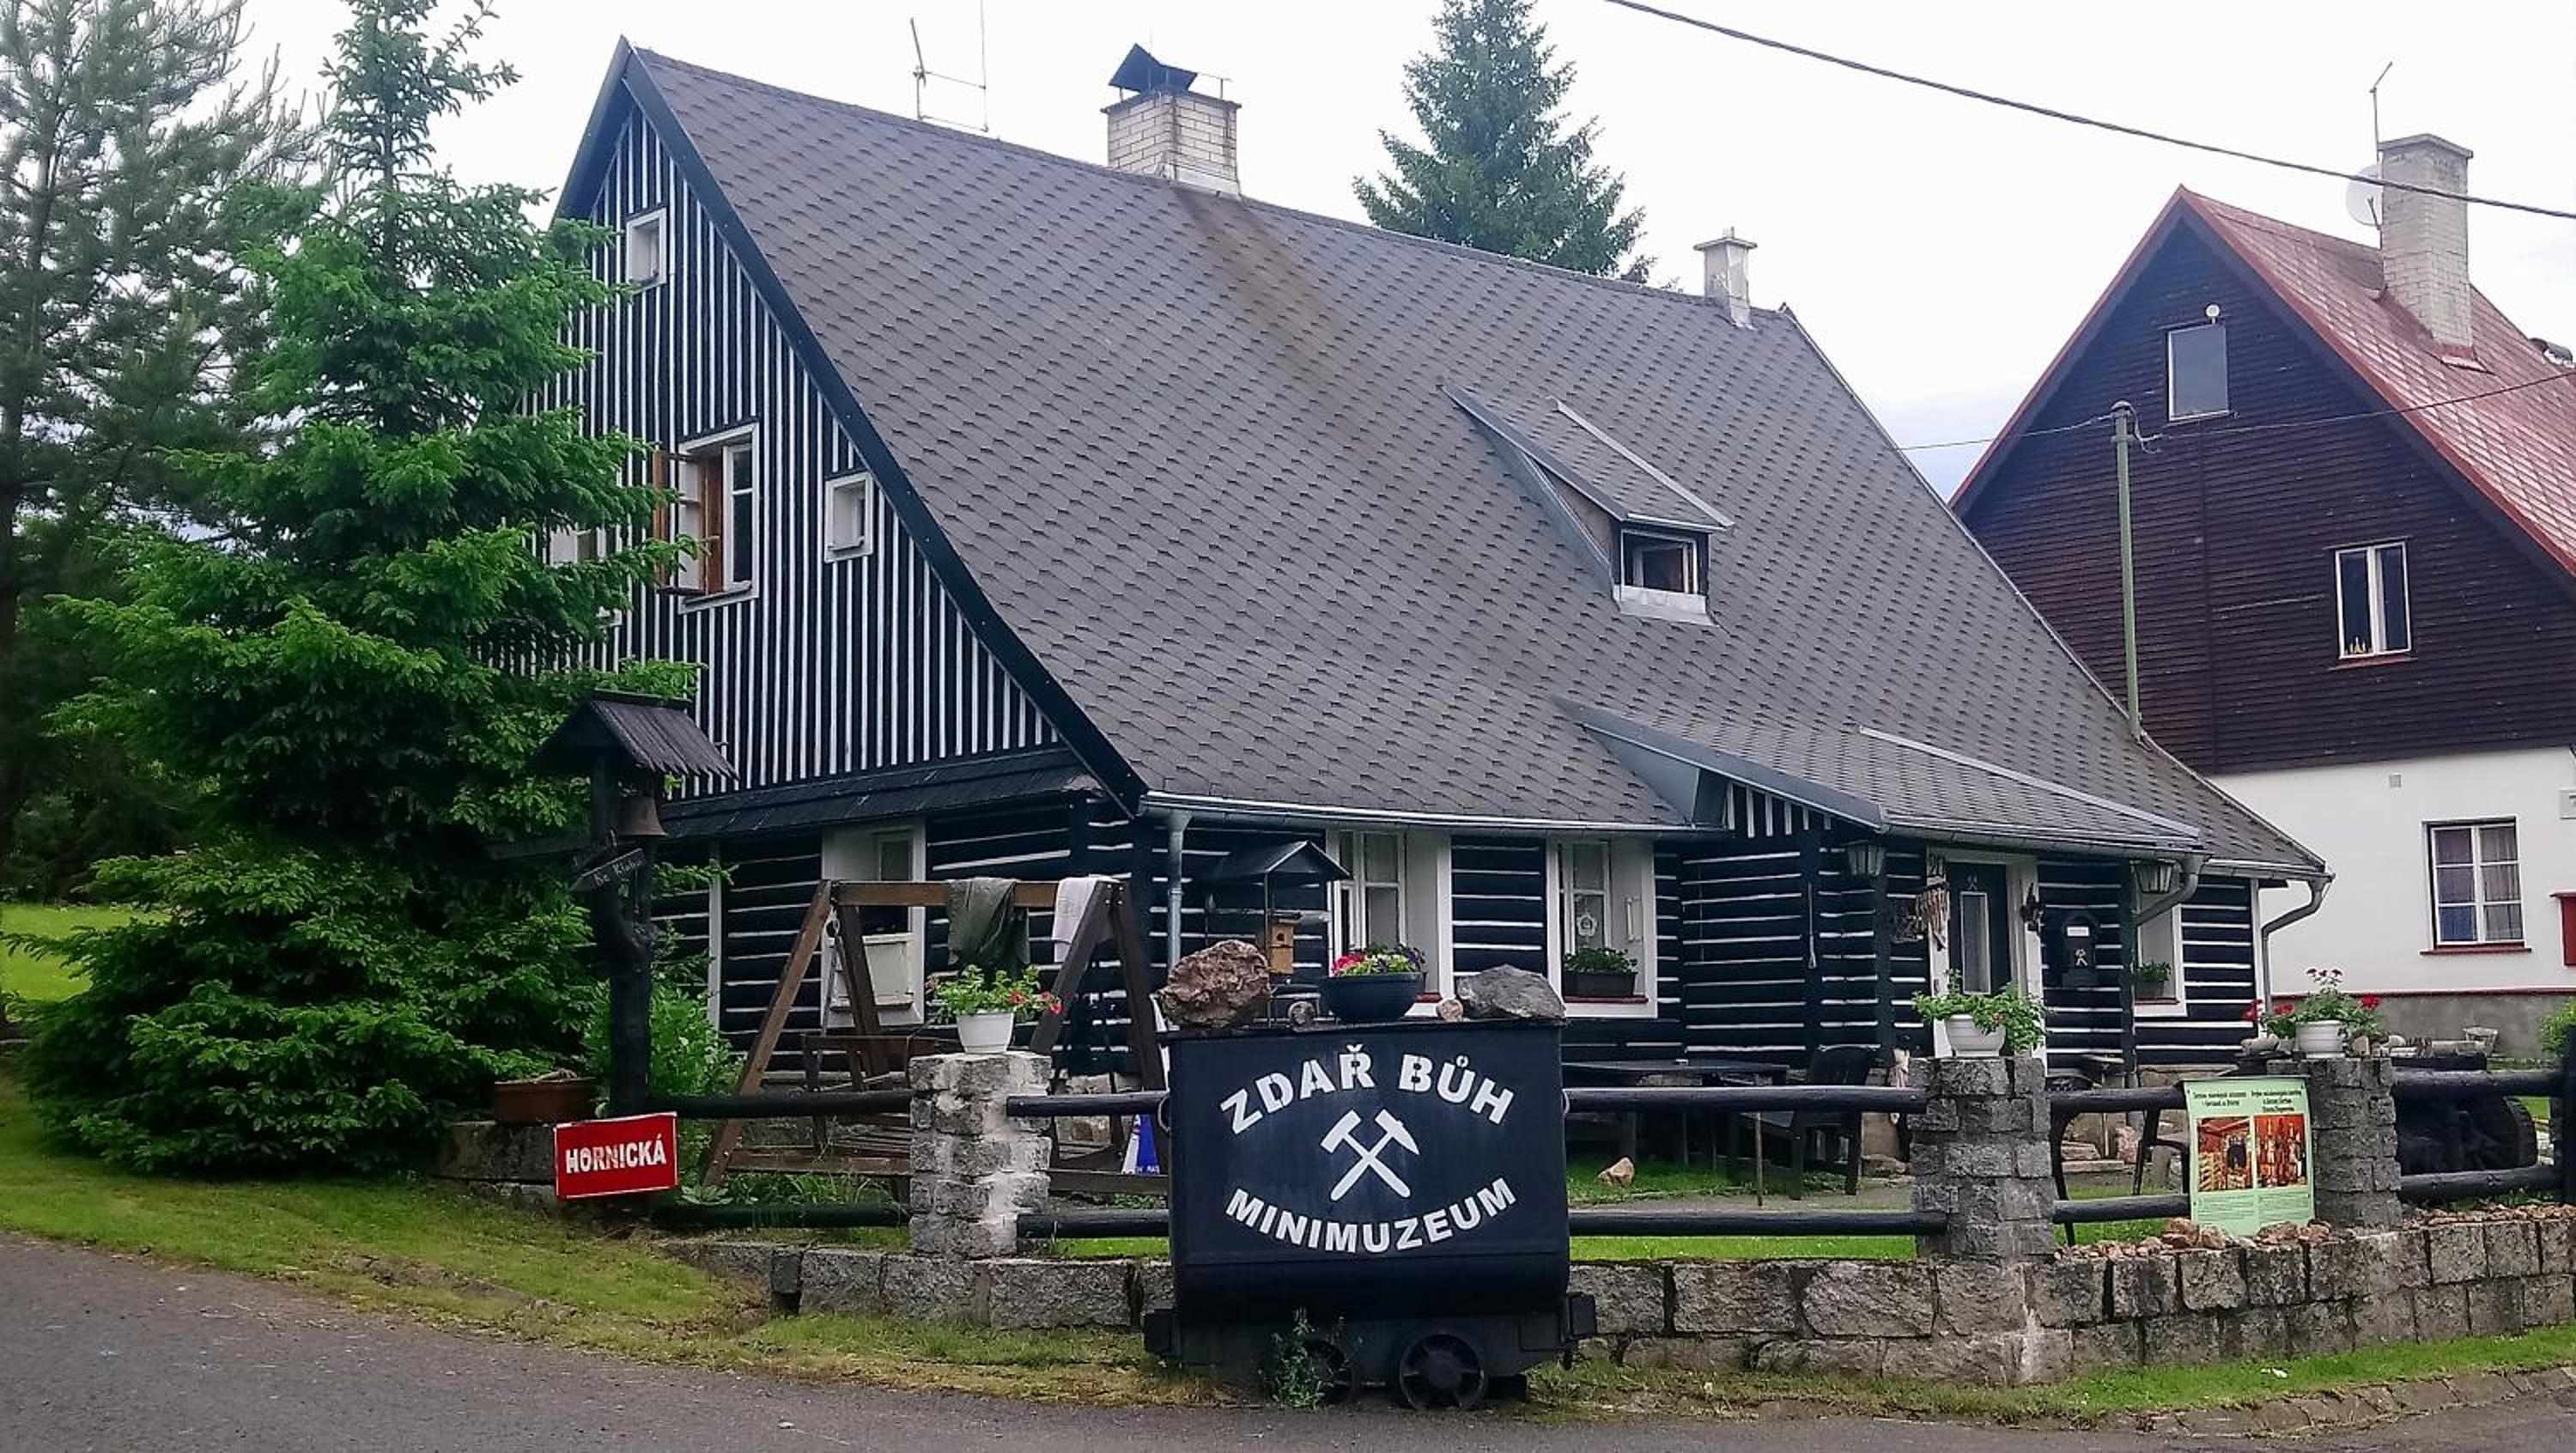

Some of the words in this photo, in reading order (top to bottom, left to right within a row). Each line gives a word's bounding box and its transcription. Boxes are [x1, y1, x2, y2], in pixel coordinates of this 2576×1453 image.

[1220, 1043, 1376, 1134] ZDAŘ
[1398, 1055, 1514, 1125] BŮH
[565, 1133, 667, 1174] HORNICKÁ
[1225, 1176, 1517, 1254] MINIMUZEUM
